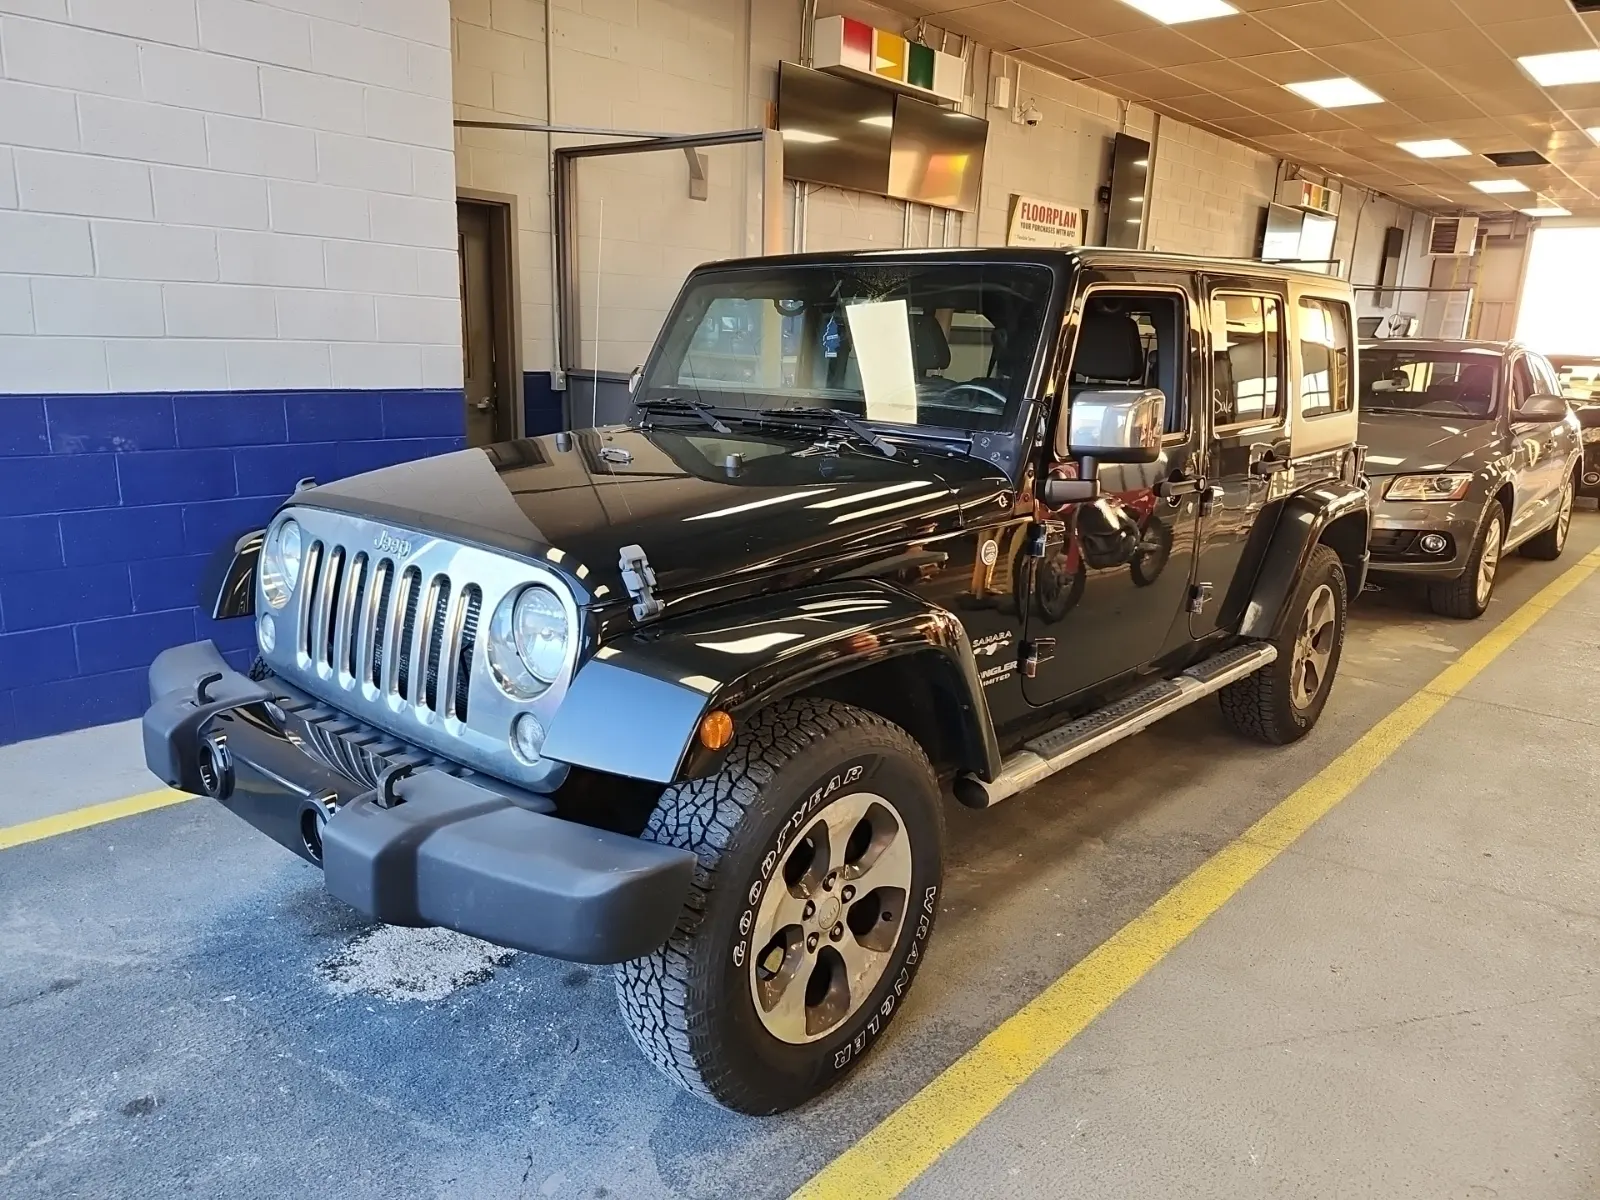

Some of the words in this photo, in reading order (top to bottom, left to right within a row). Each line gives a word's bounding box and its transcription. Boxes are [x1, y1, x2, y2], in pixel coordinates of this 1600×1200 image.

[1020, 202, 1077, 229] FLOORPLAN
[1020, 222, 1031, 230] YOUR
[1032, 224, 1055, 234] PURCHASES
[1056, 229, 1066, 237] WITH
[374, 530, 411, 559] Jeep
[972, 630, 1012, 648] SAHARA
[980, 660, 1018, 679] NGLER
[983, 672, 1011, 687] IMITED
[732, 765, 863, 967] GOODYEAR
[834, 885, 937, 1069] WRANGLER
